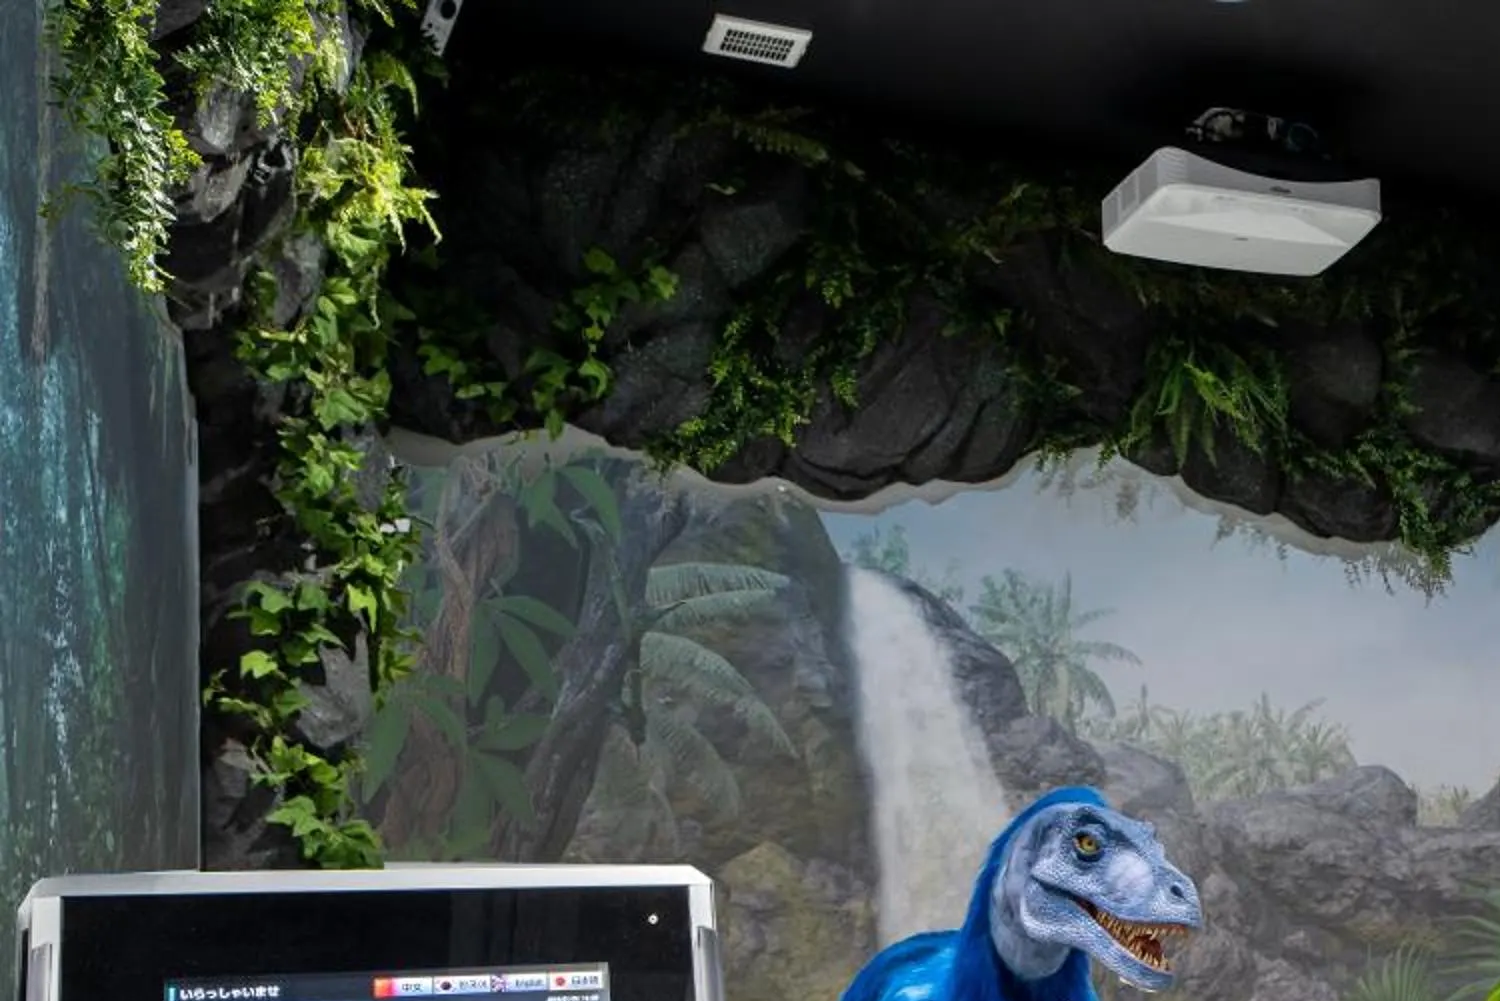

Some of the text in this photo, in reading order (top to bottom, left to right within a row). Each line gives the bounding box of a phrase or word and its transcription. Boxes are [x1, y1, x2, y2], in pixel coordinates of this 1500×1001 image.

[180, 985, 280, 1000] いらっしゃいませ
